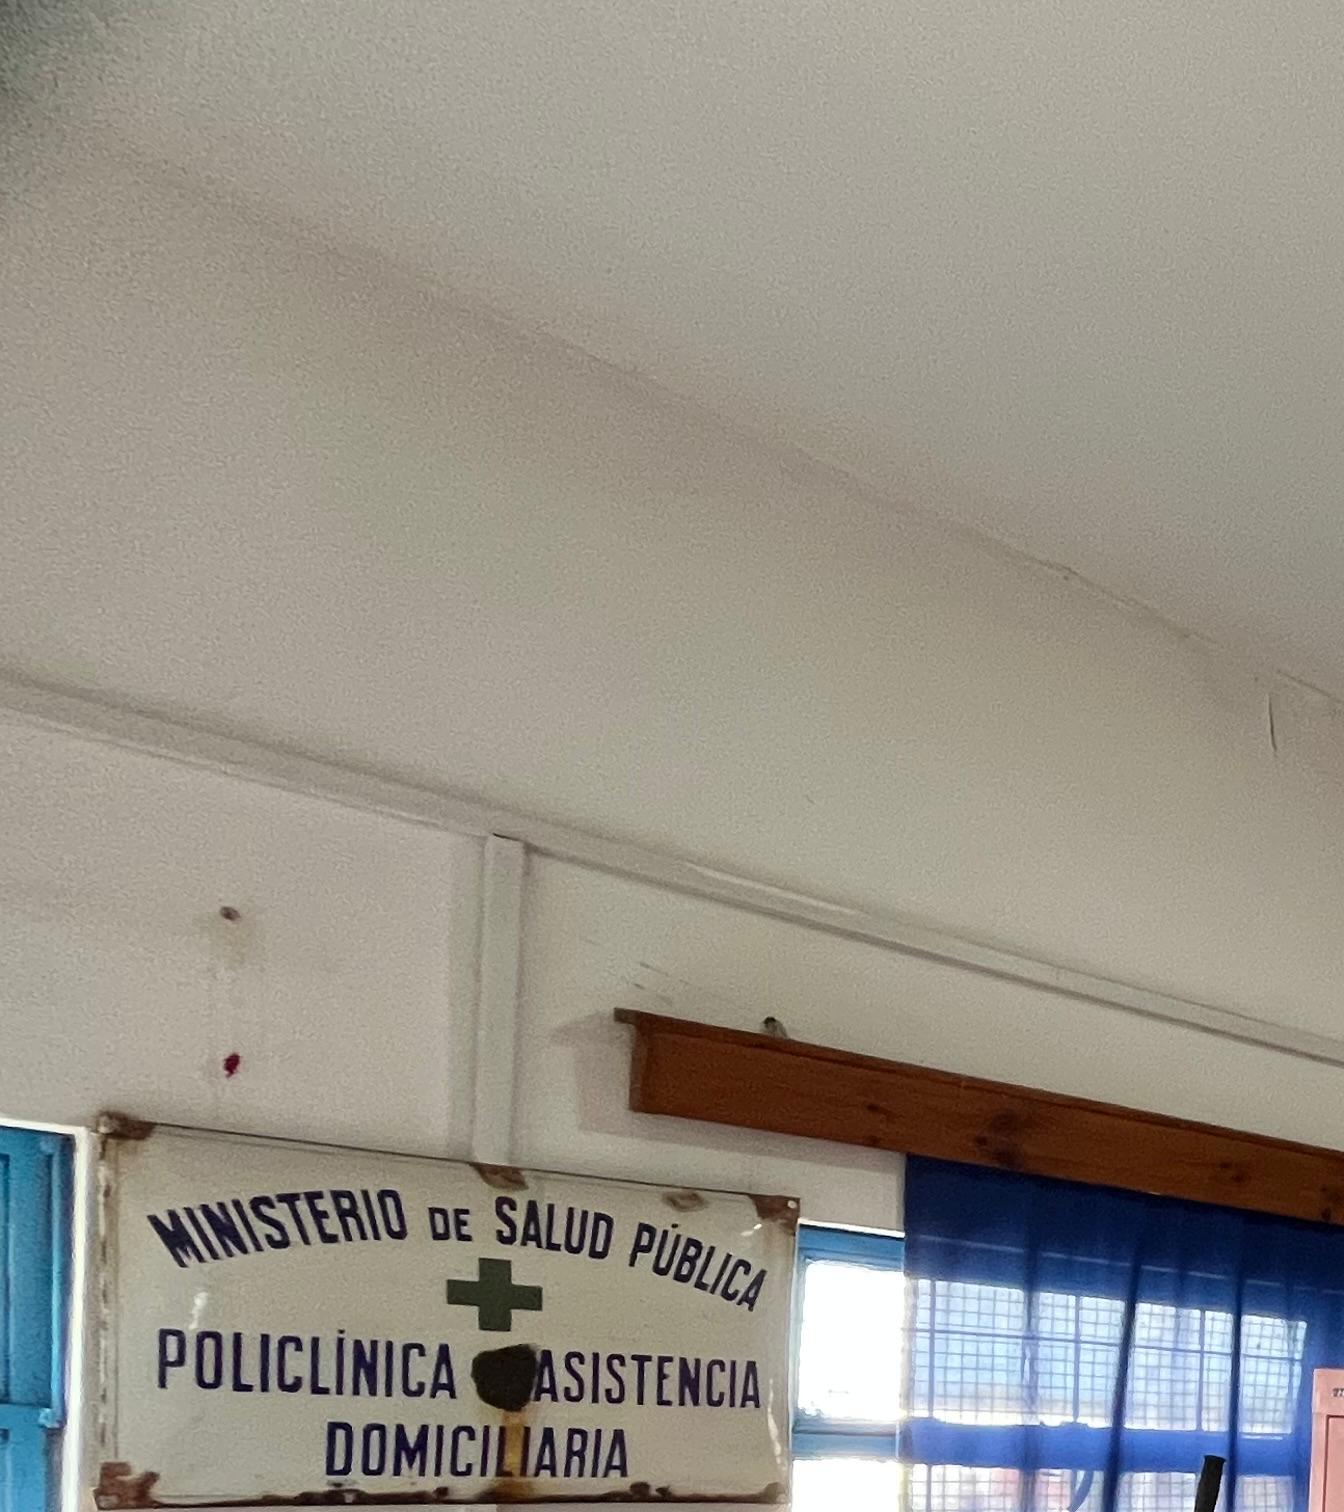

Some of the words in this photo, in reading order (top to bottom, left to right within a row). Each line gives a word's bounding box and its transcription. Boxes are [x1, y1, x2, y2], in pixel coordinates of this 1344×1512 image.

[147, 1188, 408, 1268] MINISTERIO
[495, 1196, 614, 1260] SALUD
[629, 1223, 769, 1312] PÚBLICA
[156, 1328, 457, 1400] POLICLÍNICA
[534, 1349, 762, 1409] ASISTENCIA
[325, 1421, 629, 1479] DOMICILIARIA
